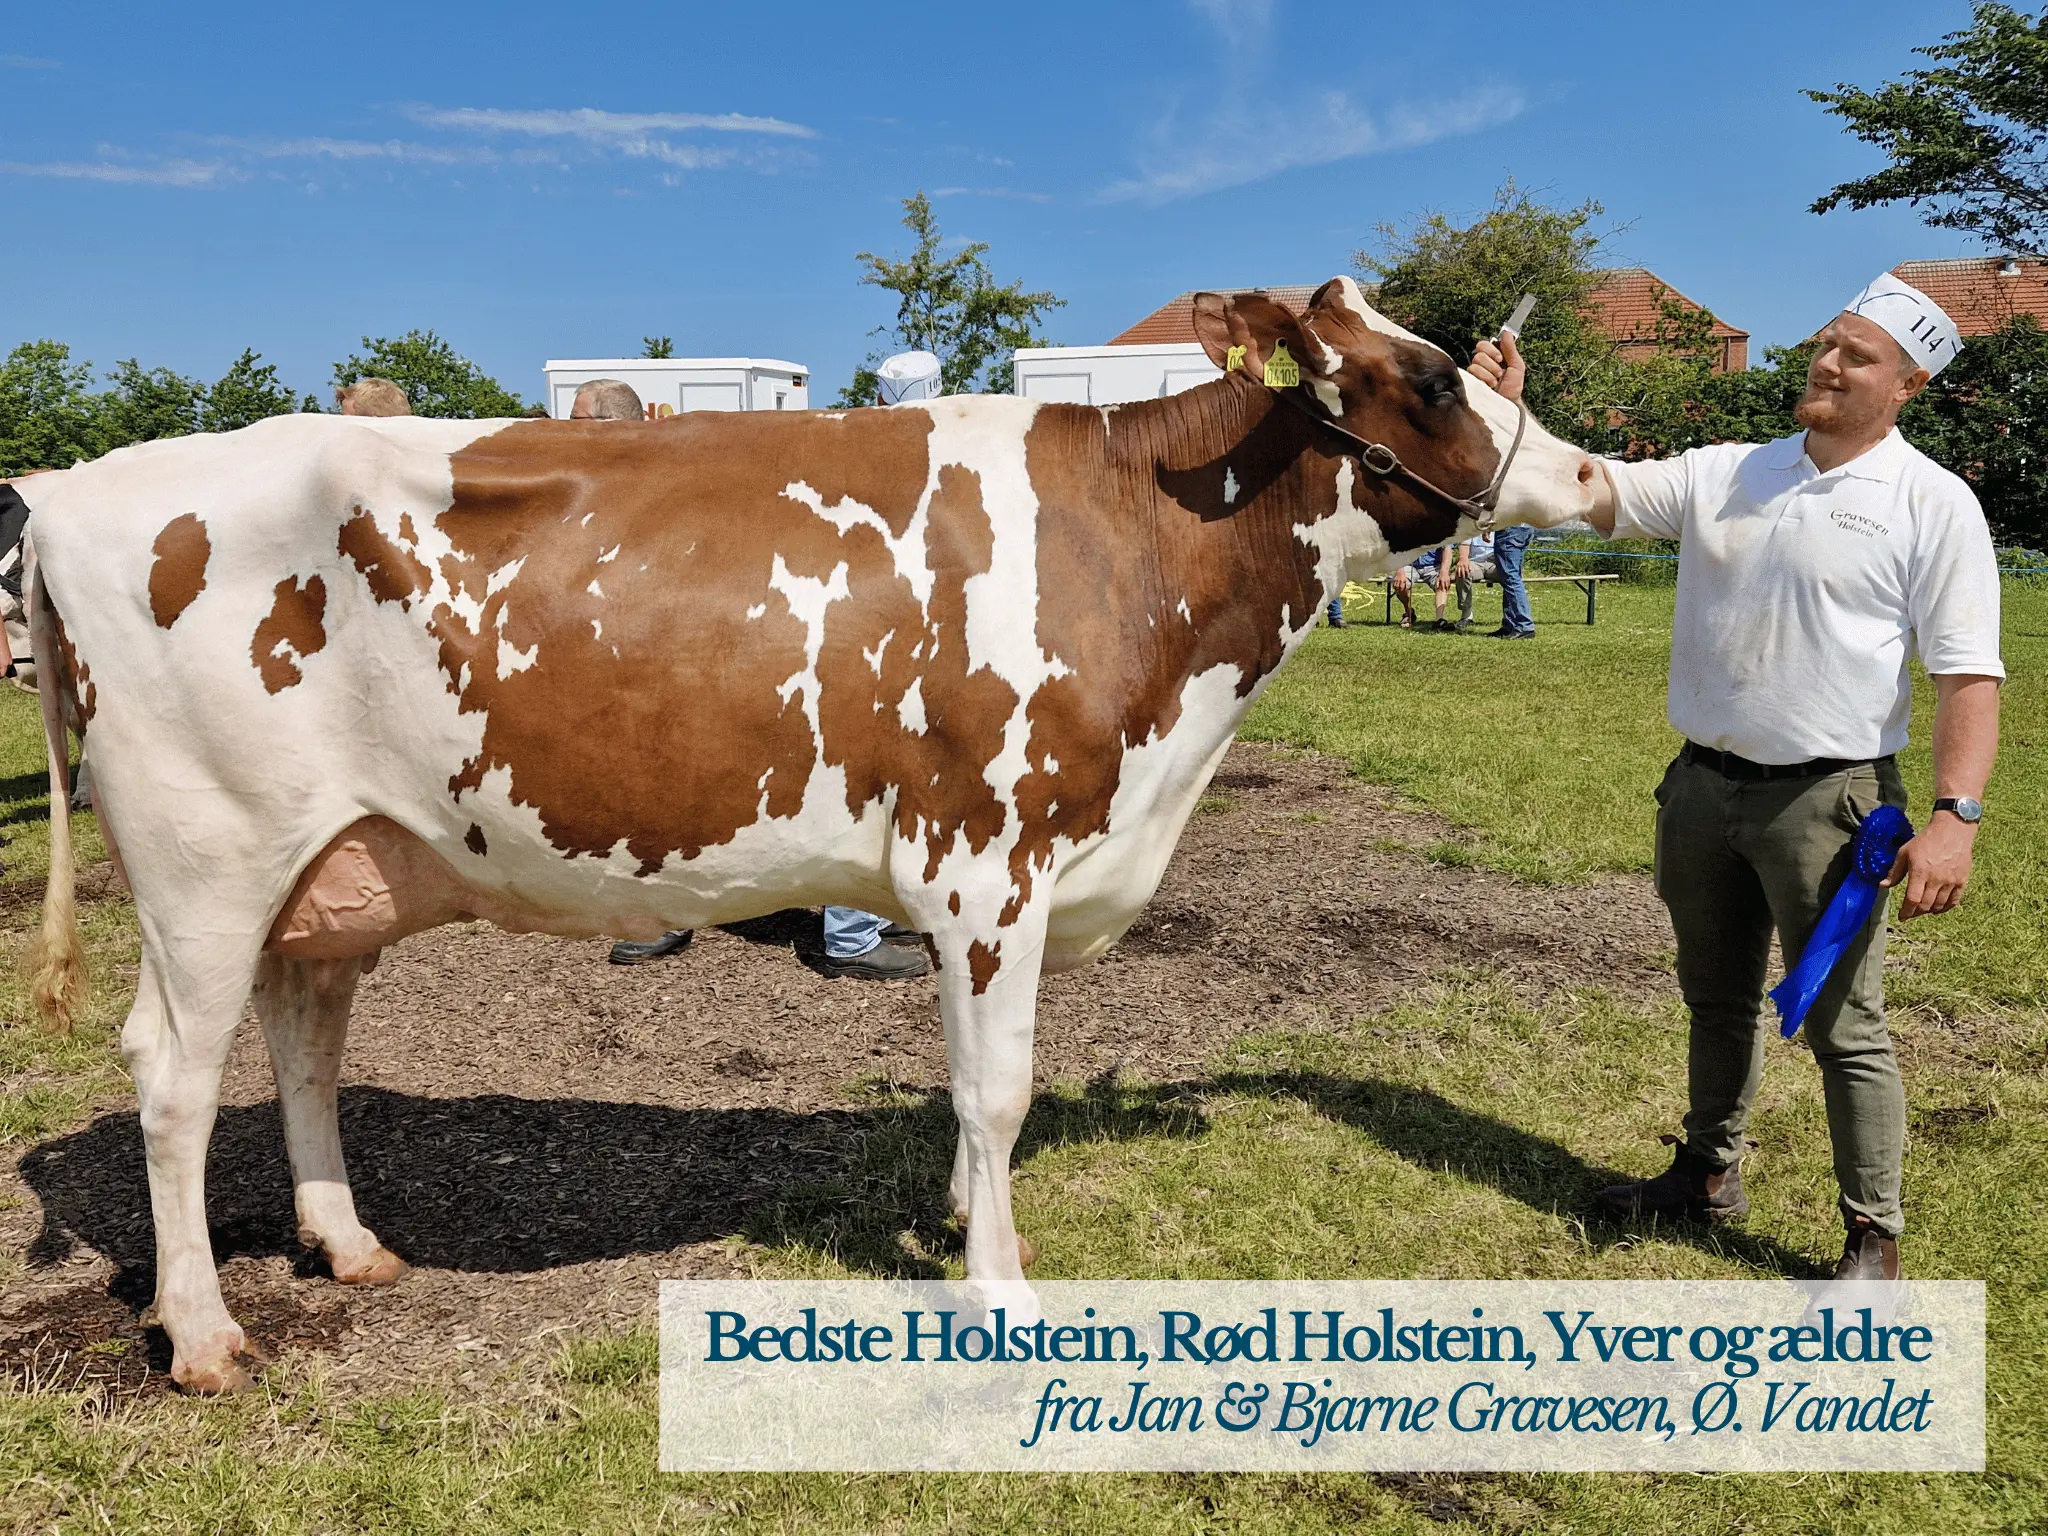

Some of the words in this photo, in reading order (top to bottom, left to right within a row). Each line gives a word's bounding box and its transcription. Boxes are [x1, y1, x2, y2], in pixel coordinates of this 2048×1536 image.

[1908, 314, 1946, 354] 114
[1266, 368, 1298, 386] 04105
[1830, 508, 1889, 536] Gravesen
[1837, 520, 1874, 539] Holstein
